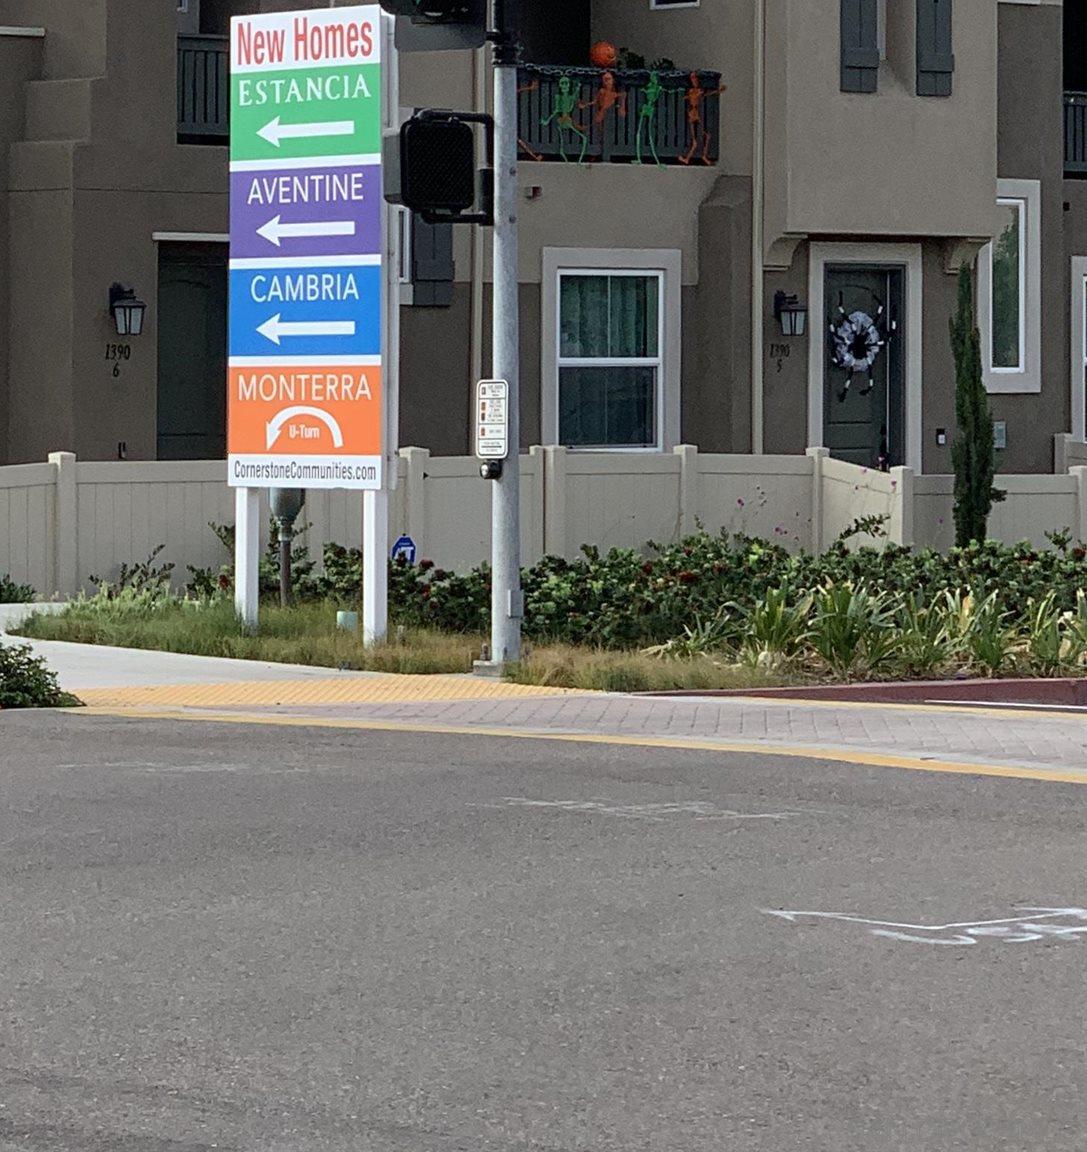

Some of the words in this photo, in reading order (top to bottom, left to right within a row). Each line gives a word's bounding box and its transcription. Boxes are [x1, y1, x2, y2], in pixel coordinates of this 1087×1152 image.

[237, 22, 285, 65] New
[294, 17, 373, 61] Homes
[238, 73, 371, 107] ESTANCIA
[247, 173, 364, 205] AVENTINE
[250, 273, 359, 302] CAMBRIA
[105, 344, 131, 360] 1390
[113, 362, 119, 377] 6
[238, 373, 372, 402] MONTERRA
[289, 424, 320, 439] U-Turn
[234, 460, 377, 481] CornerstoneCommunities.com
